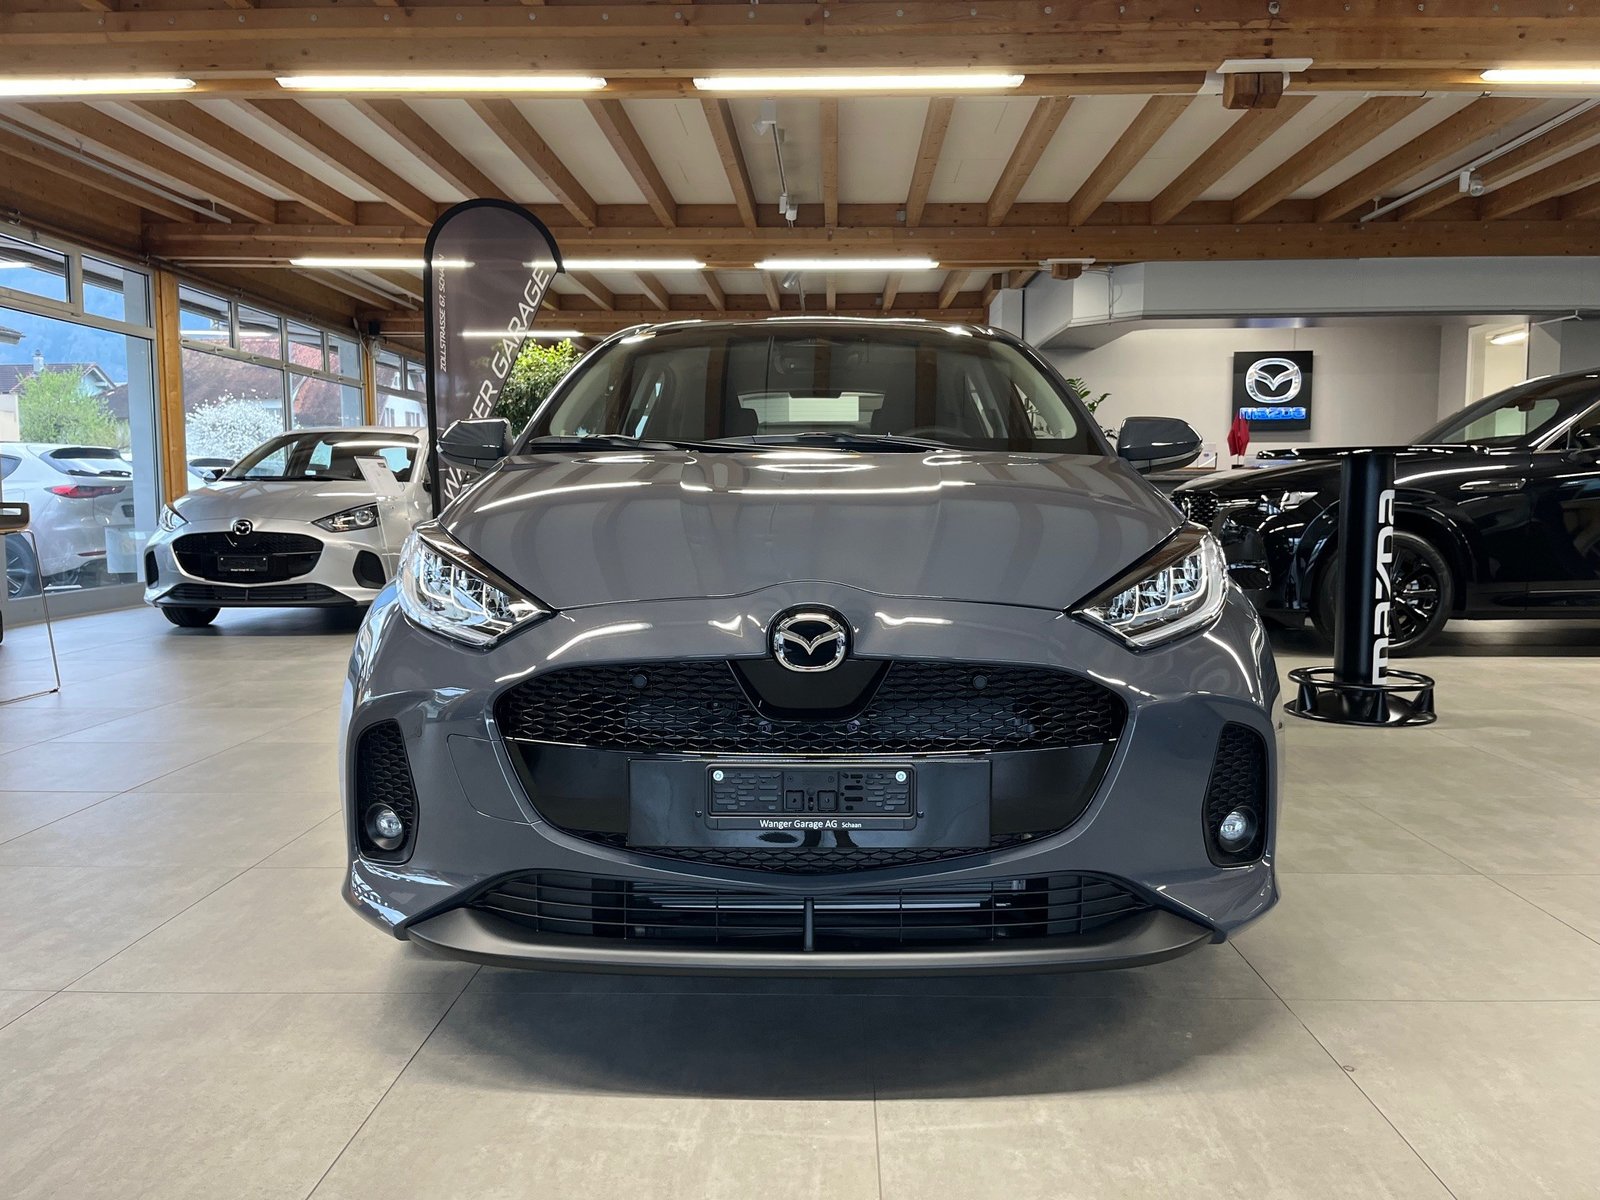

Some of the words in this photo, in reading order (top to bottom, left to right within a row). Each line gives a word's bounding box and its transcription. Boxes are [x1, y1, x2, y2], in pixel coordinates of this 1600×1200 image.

[438, 253, 446, 293] SCHAN
[439, 295, 447, 308] 67,
[439, 308, 447, 373] ZOLLSTRASSE
[491, 265, 550, 379] GARAGE
[759, 819, 792, 829] Wanger
[794, 819, 823, 829] Garage
[825, 819, 838, 828] AG
